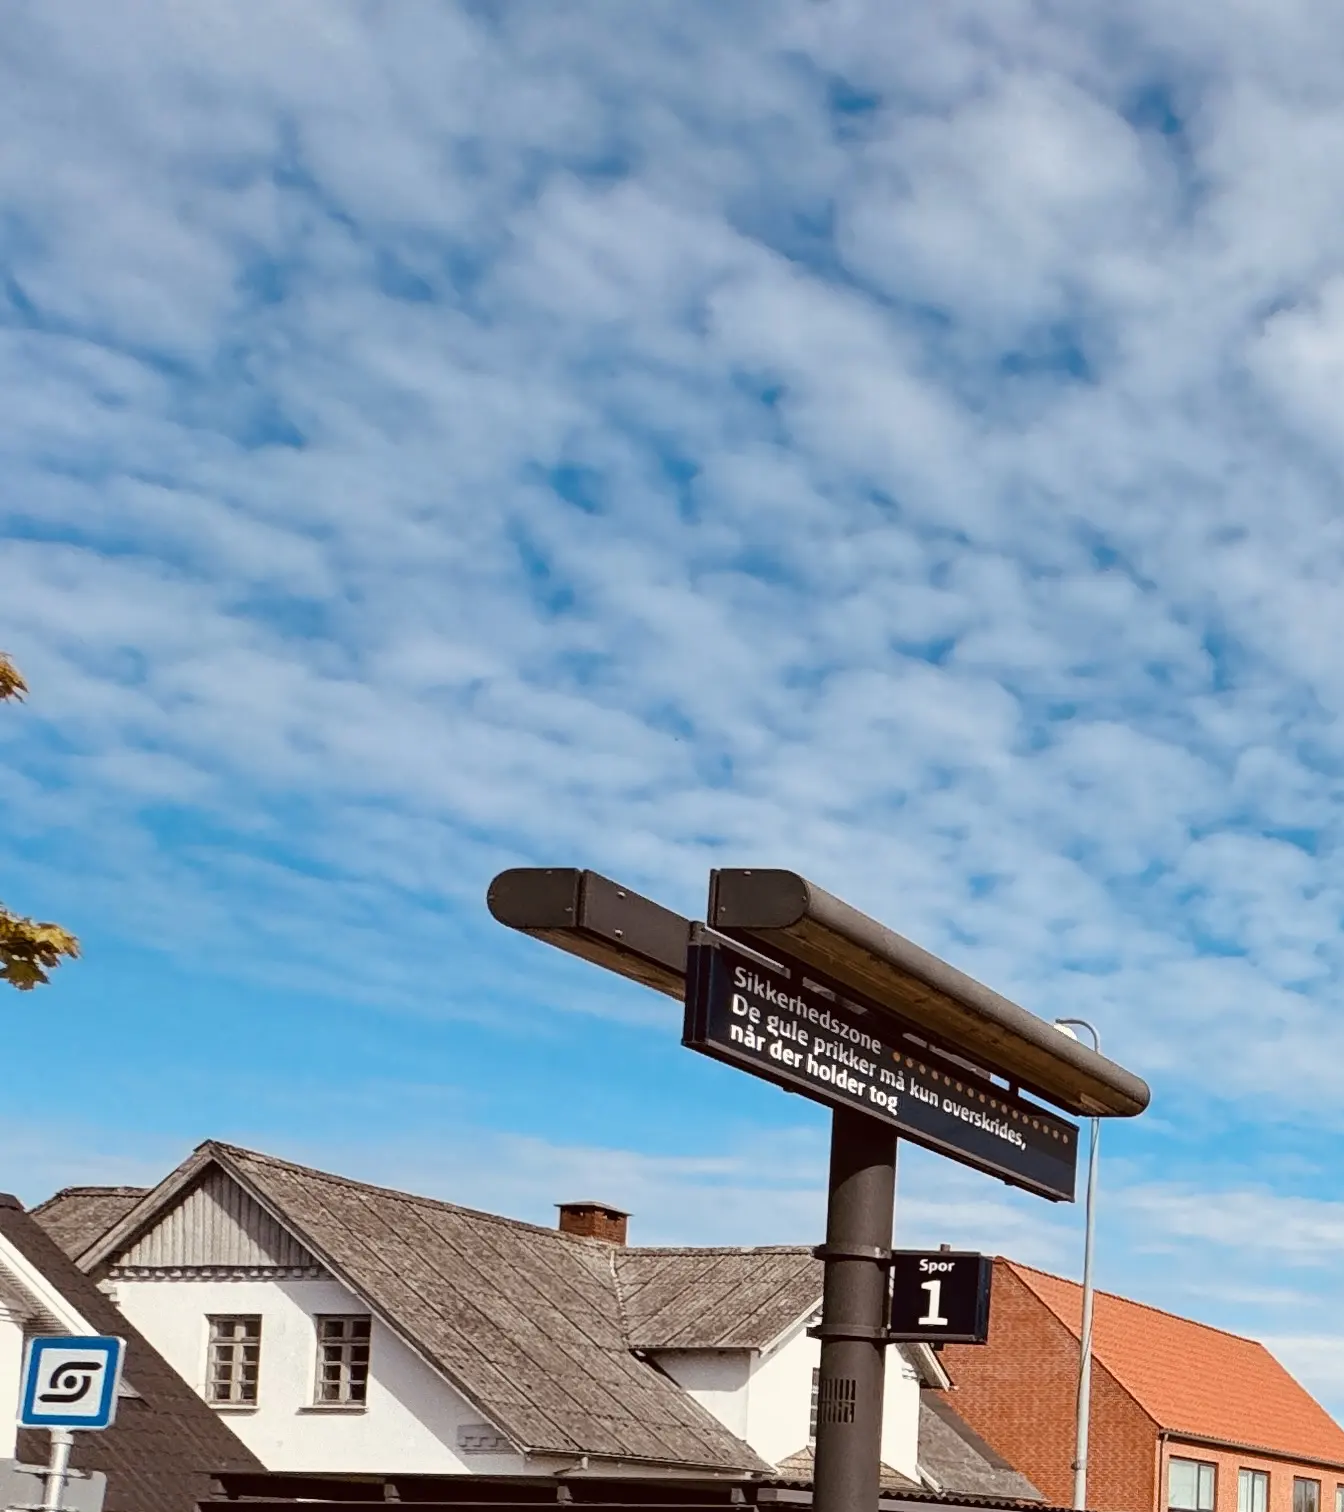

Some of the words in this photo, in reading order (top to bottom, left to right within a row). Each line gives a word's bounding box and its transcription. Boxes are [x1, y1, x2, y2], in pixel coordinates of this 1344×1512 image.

[733, 966, 882, 1055] Sikkerhedszone
[730, 1023, 766, 1052] når
[769, 1039, 803, 1068] der
[806, 1053, 866, 1097] holder
[869, 1085, 899, 1116] tog
[732, 993, 761, 1024] De
[766, 1015, 809, 1047] gule
[814, 1036, 877, 1077] prikker
[880, 1068, 905, 1092] må
[910, 1077, 939, 1108] kun
[942, 1098, 1027, 1151] overskrides,
[917, 1279, 949, 1326] 1
[918, 1258, 956, 1275] Spor
